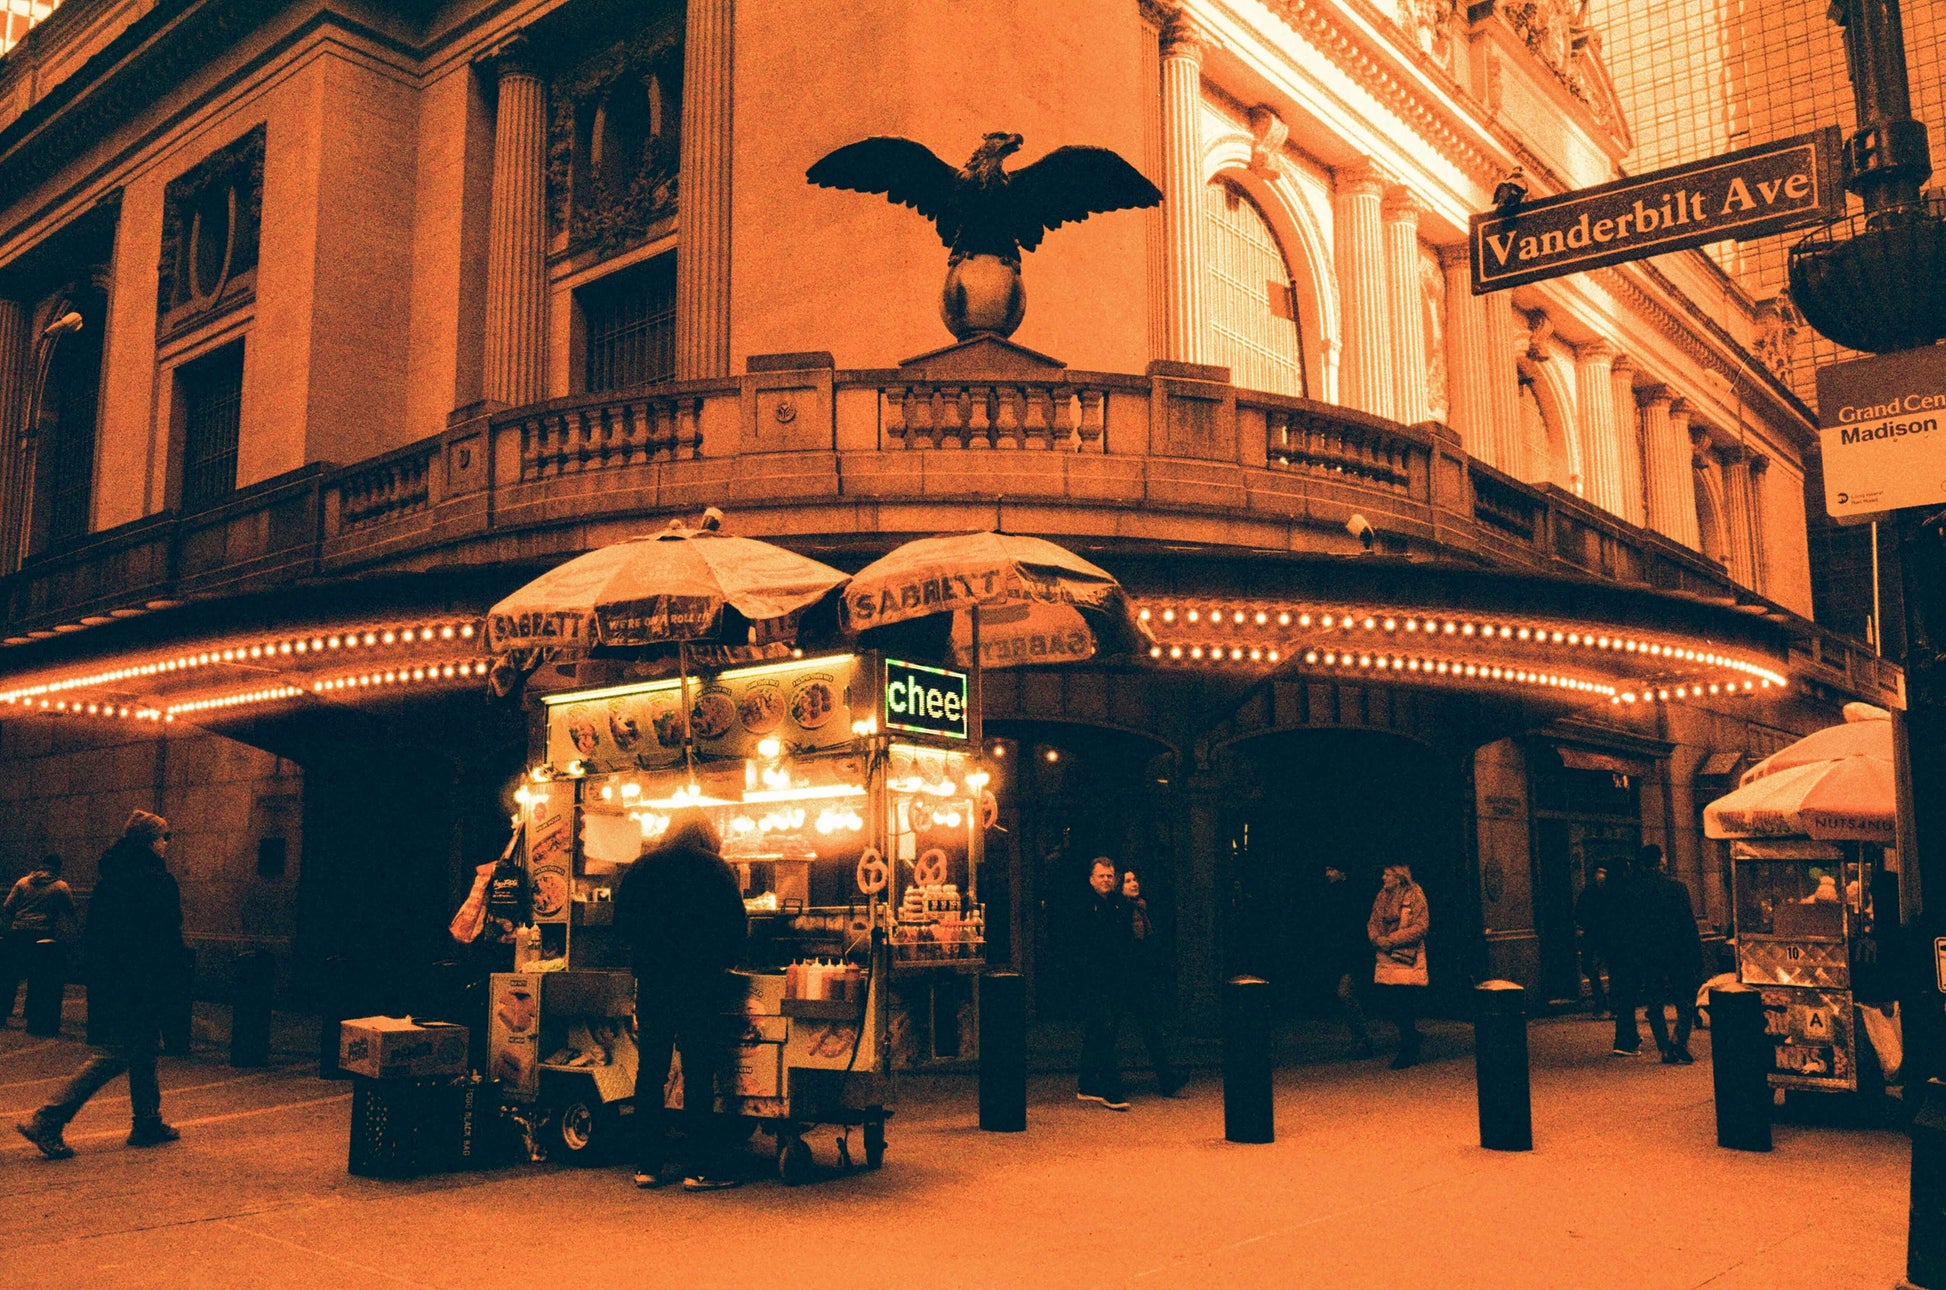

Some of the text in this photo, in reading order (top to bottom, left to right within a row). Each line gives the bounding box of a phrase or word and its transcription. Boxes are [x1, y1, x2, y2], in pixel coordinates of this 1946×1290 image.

[1486, 173, 1810, 267] Vanderbilt Ave
[1838, 394, 1946, 423] Grand Cen
[1840, 418, 1937, 445] Madison
[855, 569, 1000, 619] SABRETT
[1787, 947, 1799, 960] 10
[1809, 1012, 1823, 1028] A
